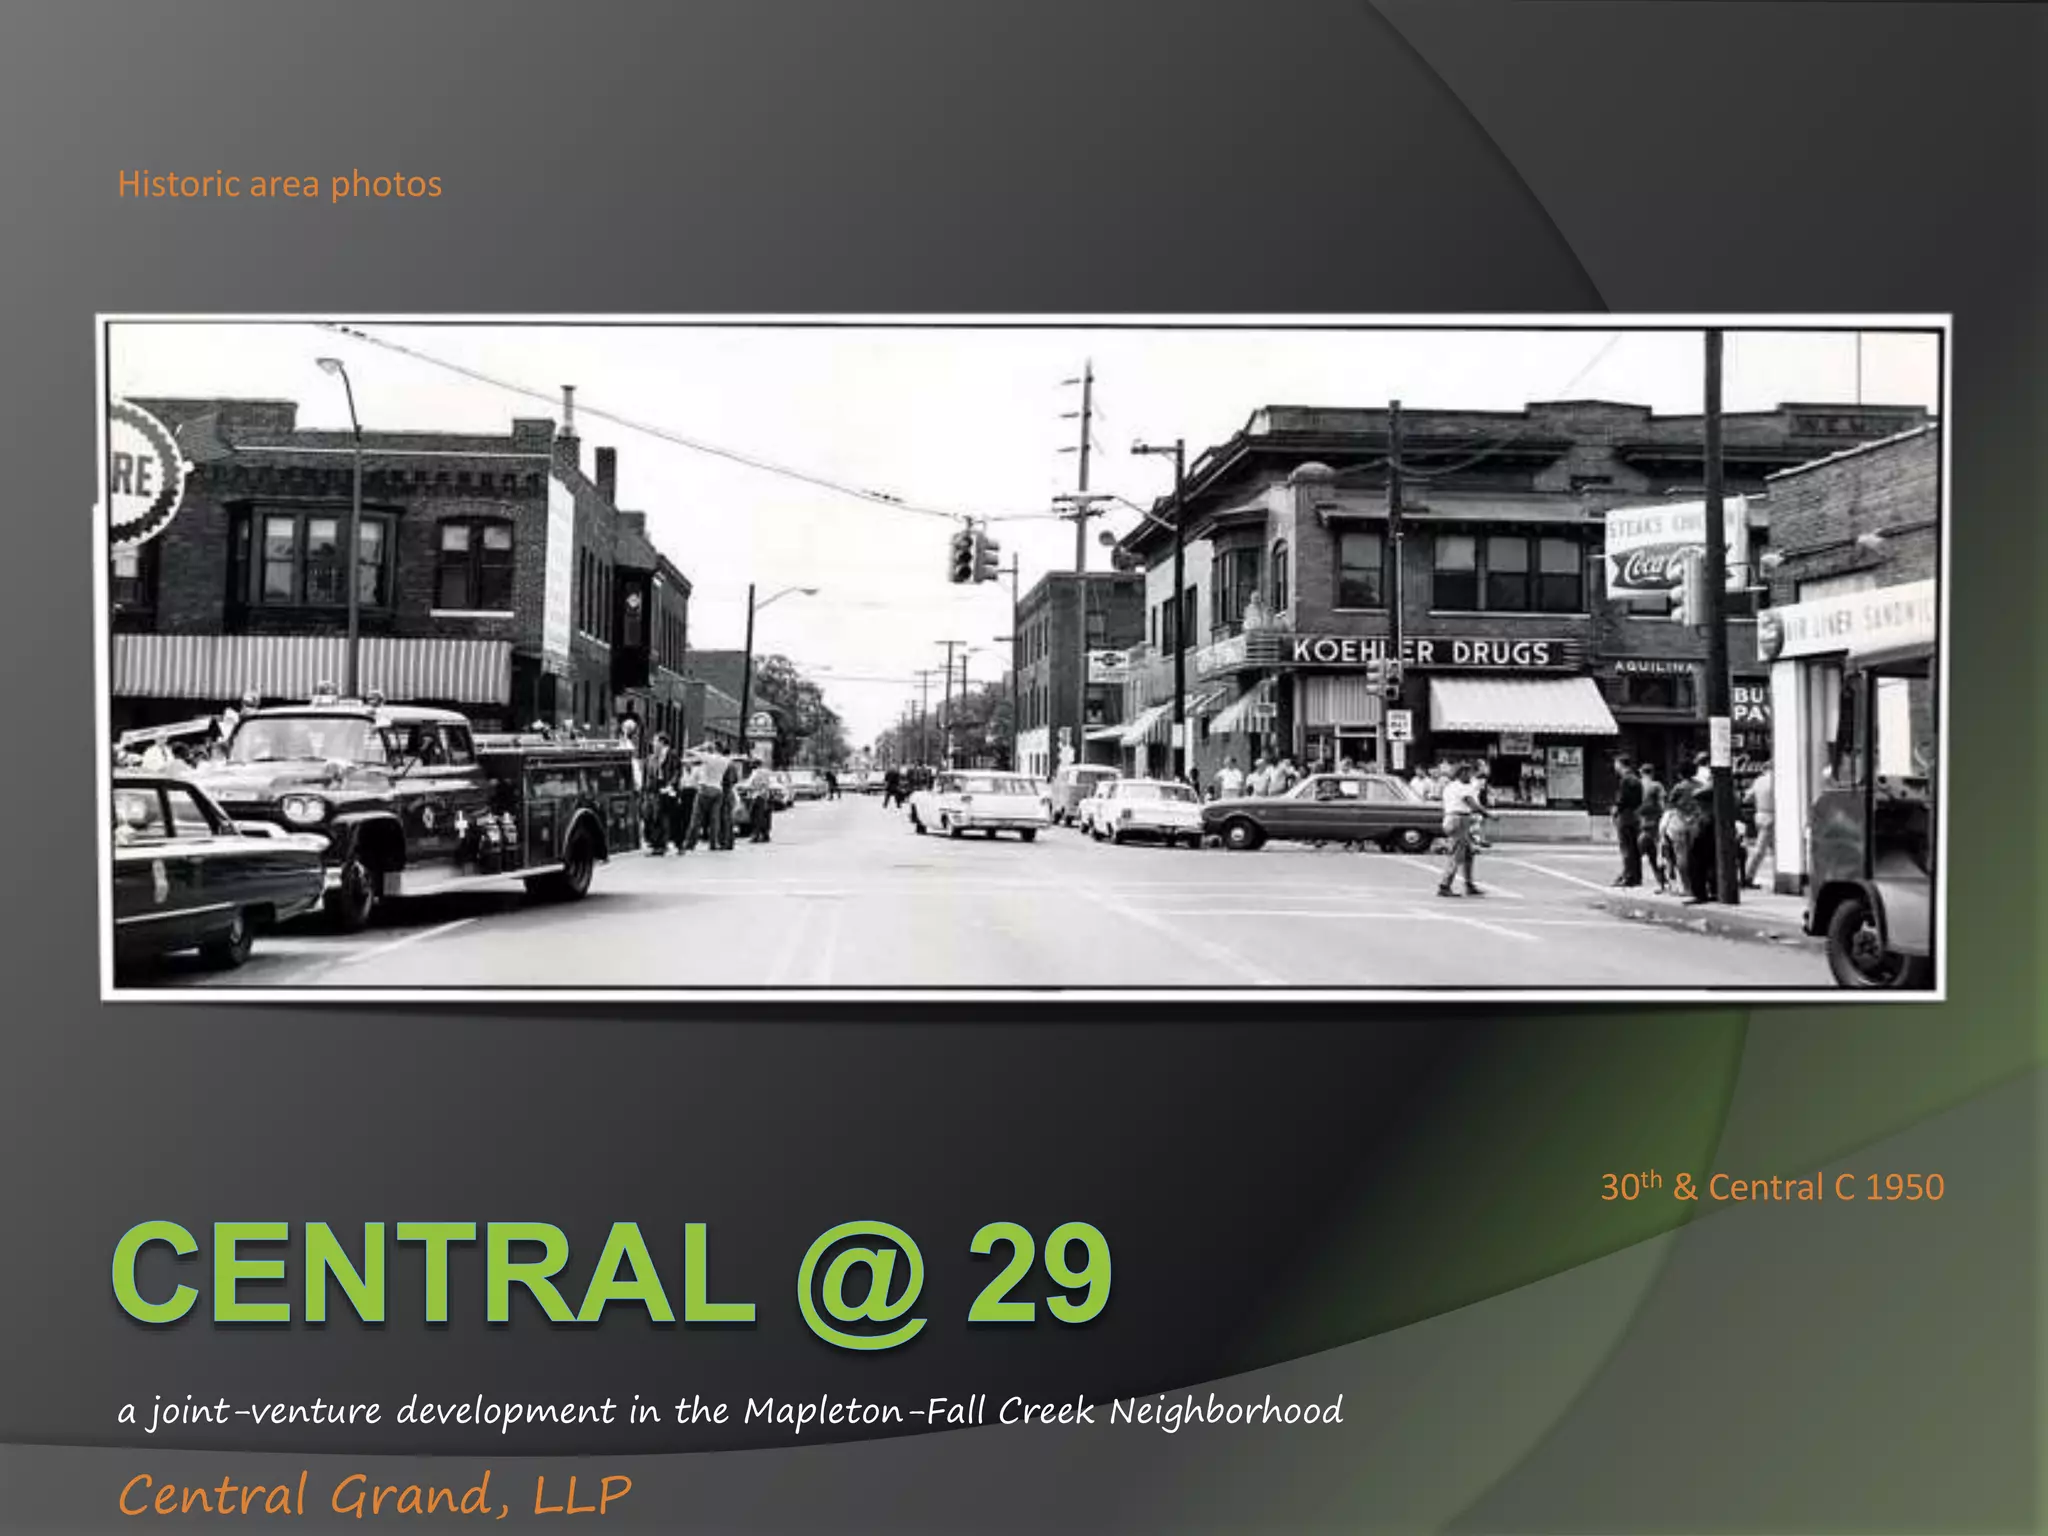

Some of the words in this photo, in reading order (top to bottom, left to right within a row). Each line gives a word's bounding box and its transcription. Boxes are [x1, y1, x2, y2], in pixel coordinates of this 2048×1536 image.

[111, 451, 154, 498] RE
[1293, 638, 1435, 663] KOEHLER
[1452, 640, 1550, 665] DRUGS
[1614, 659, 1695, 674] AQUILINA
